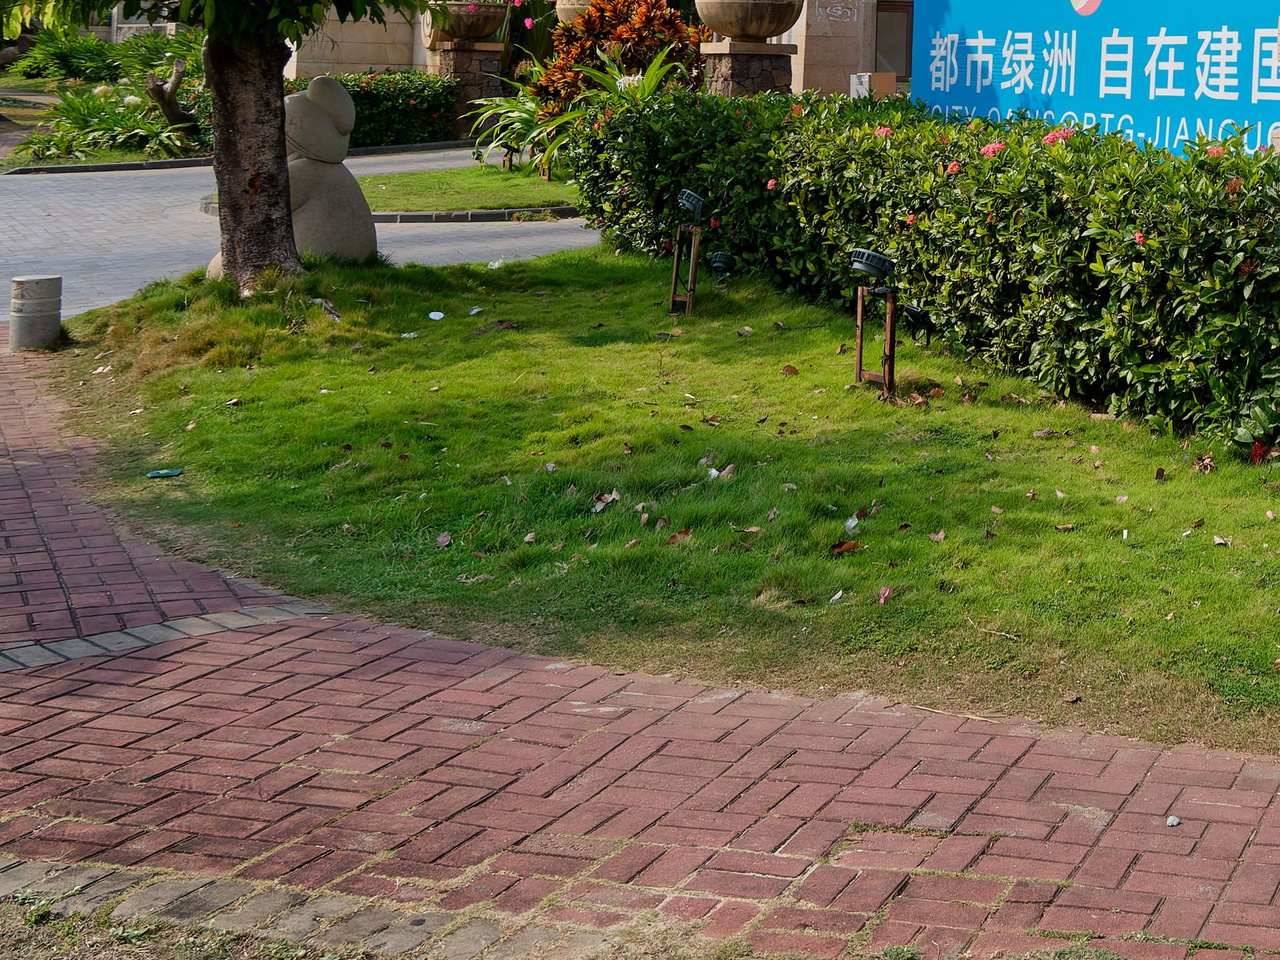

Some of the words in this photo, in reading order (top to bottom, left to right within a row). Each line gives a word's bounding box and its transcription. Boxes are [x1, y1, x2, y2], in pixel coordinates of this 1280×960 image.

[929, 29, 1077, 97] 都市绿洲
[987, 107, 1055, 127] OAS
